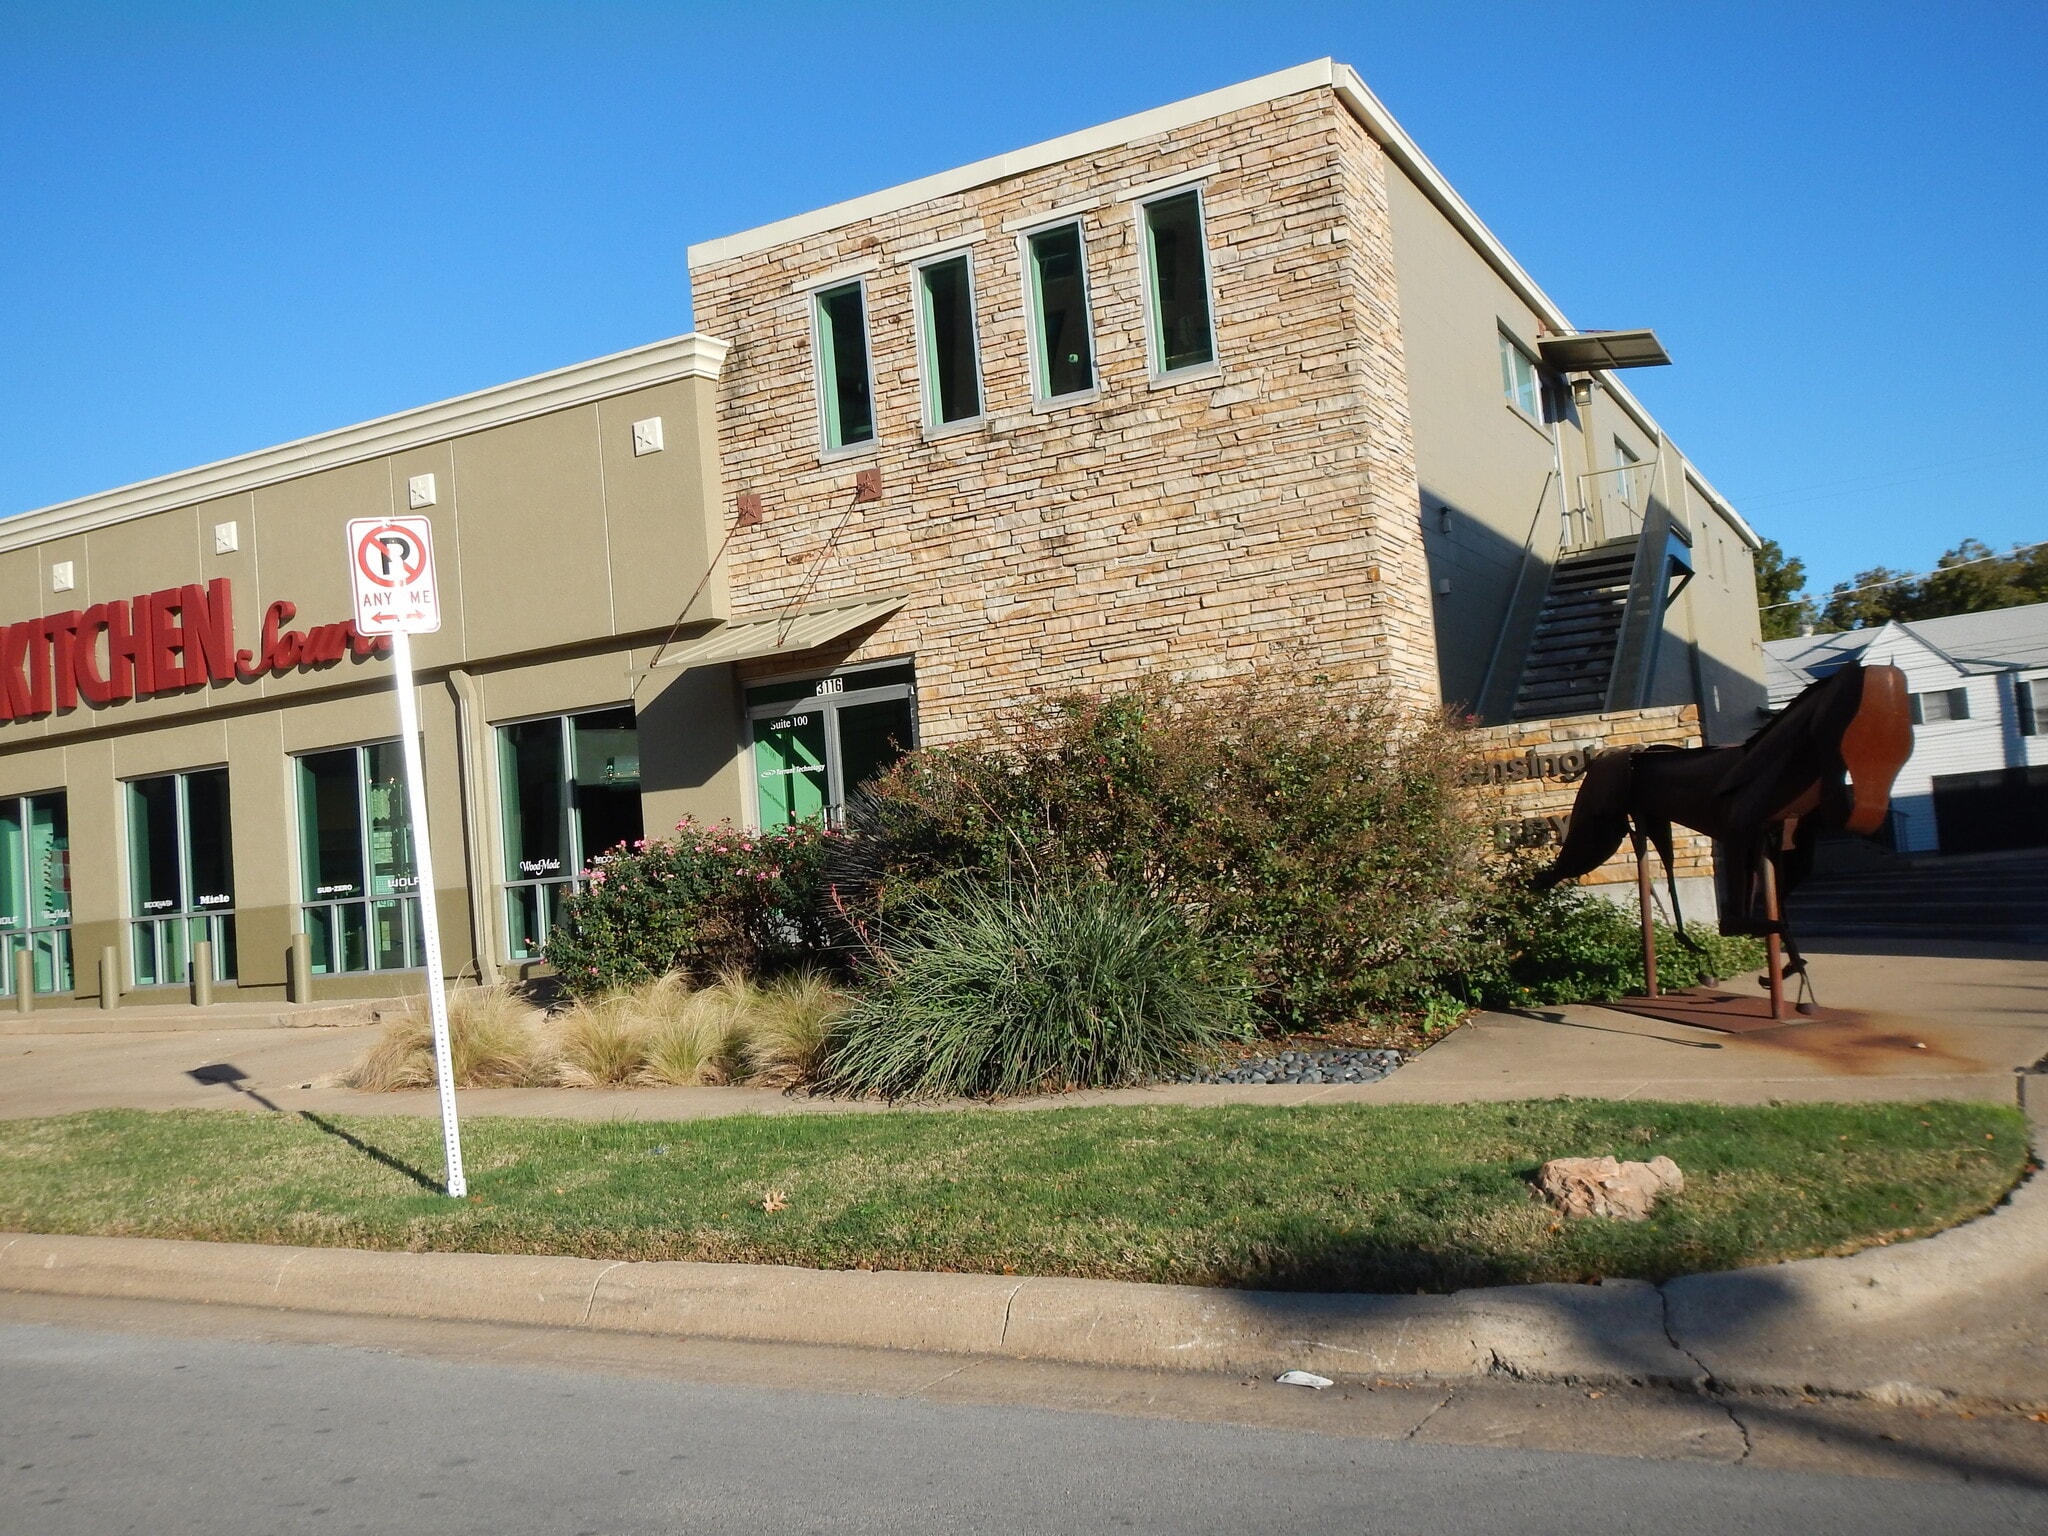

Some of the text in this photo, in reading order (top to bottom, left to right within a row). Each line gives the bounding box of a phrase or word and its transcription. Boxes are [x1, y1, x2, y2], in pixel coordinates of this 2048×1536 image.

[364, 592, 392, 607] ANY
[0, 578, 235, 719] KITCHEN
[817, 679, 842, 695] 3116
[770, 715, 808, 730] Suite 100
[199, 893, 230, 905] Miele
